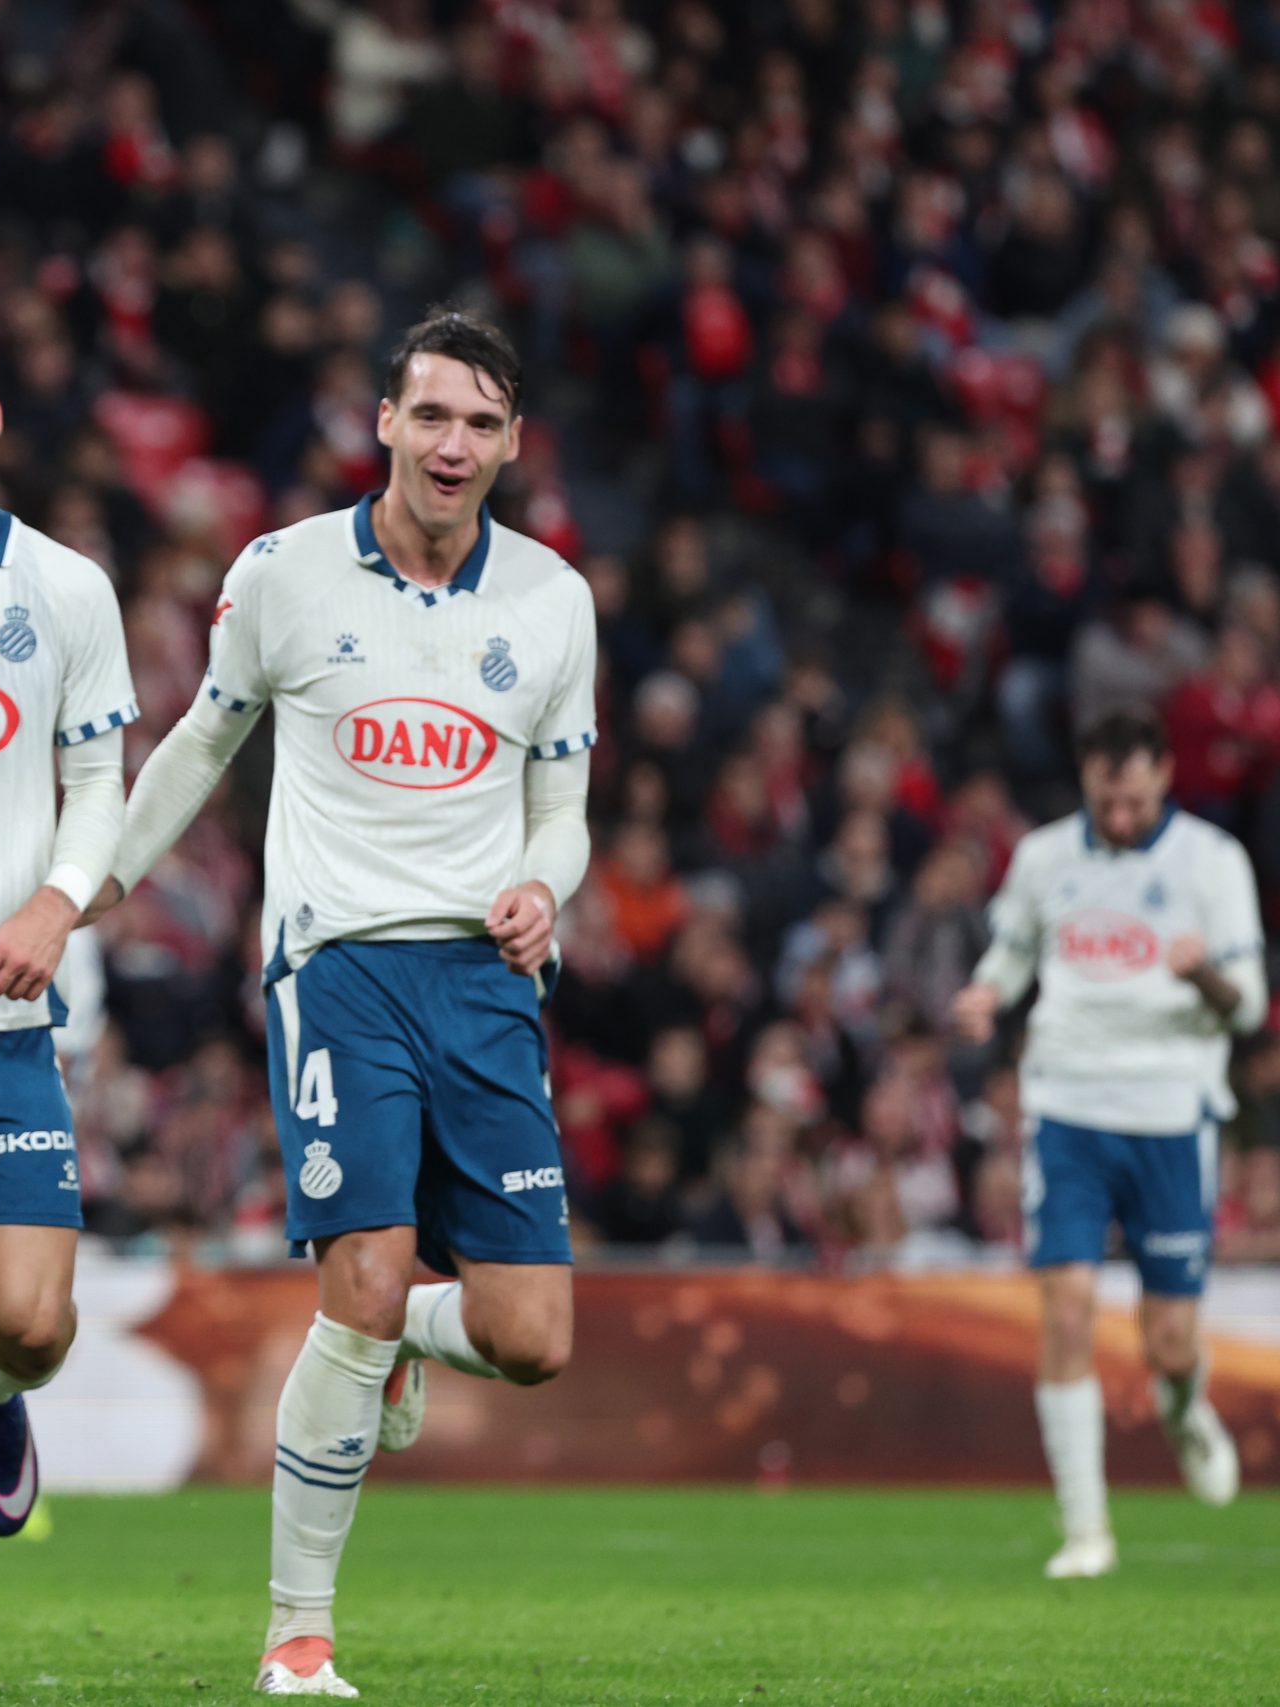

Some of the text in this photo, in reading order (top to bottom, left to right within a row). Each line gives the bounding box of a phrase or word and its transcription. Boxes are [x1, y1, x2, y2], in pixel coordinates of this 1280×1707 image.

[351, 717, 473, 771] DANI
[295, 1047, 339, 1127] 4
[501, 1166, 565, 1193] SKO
